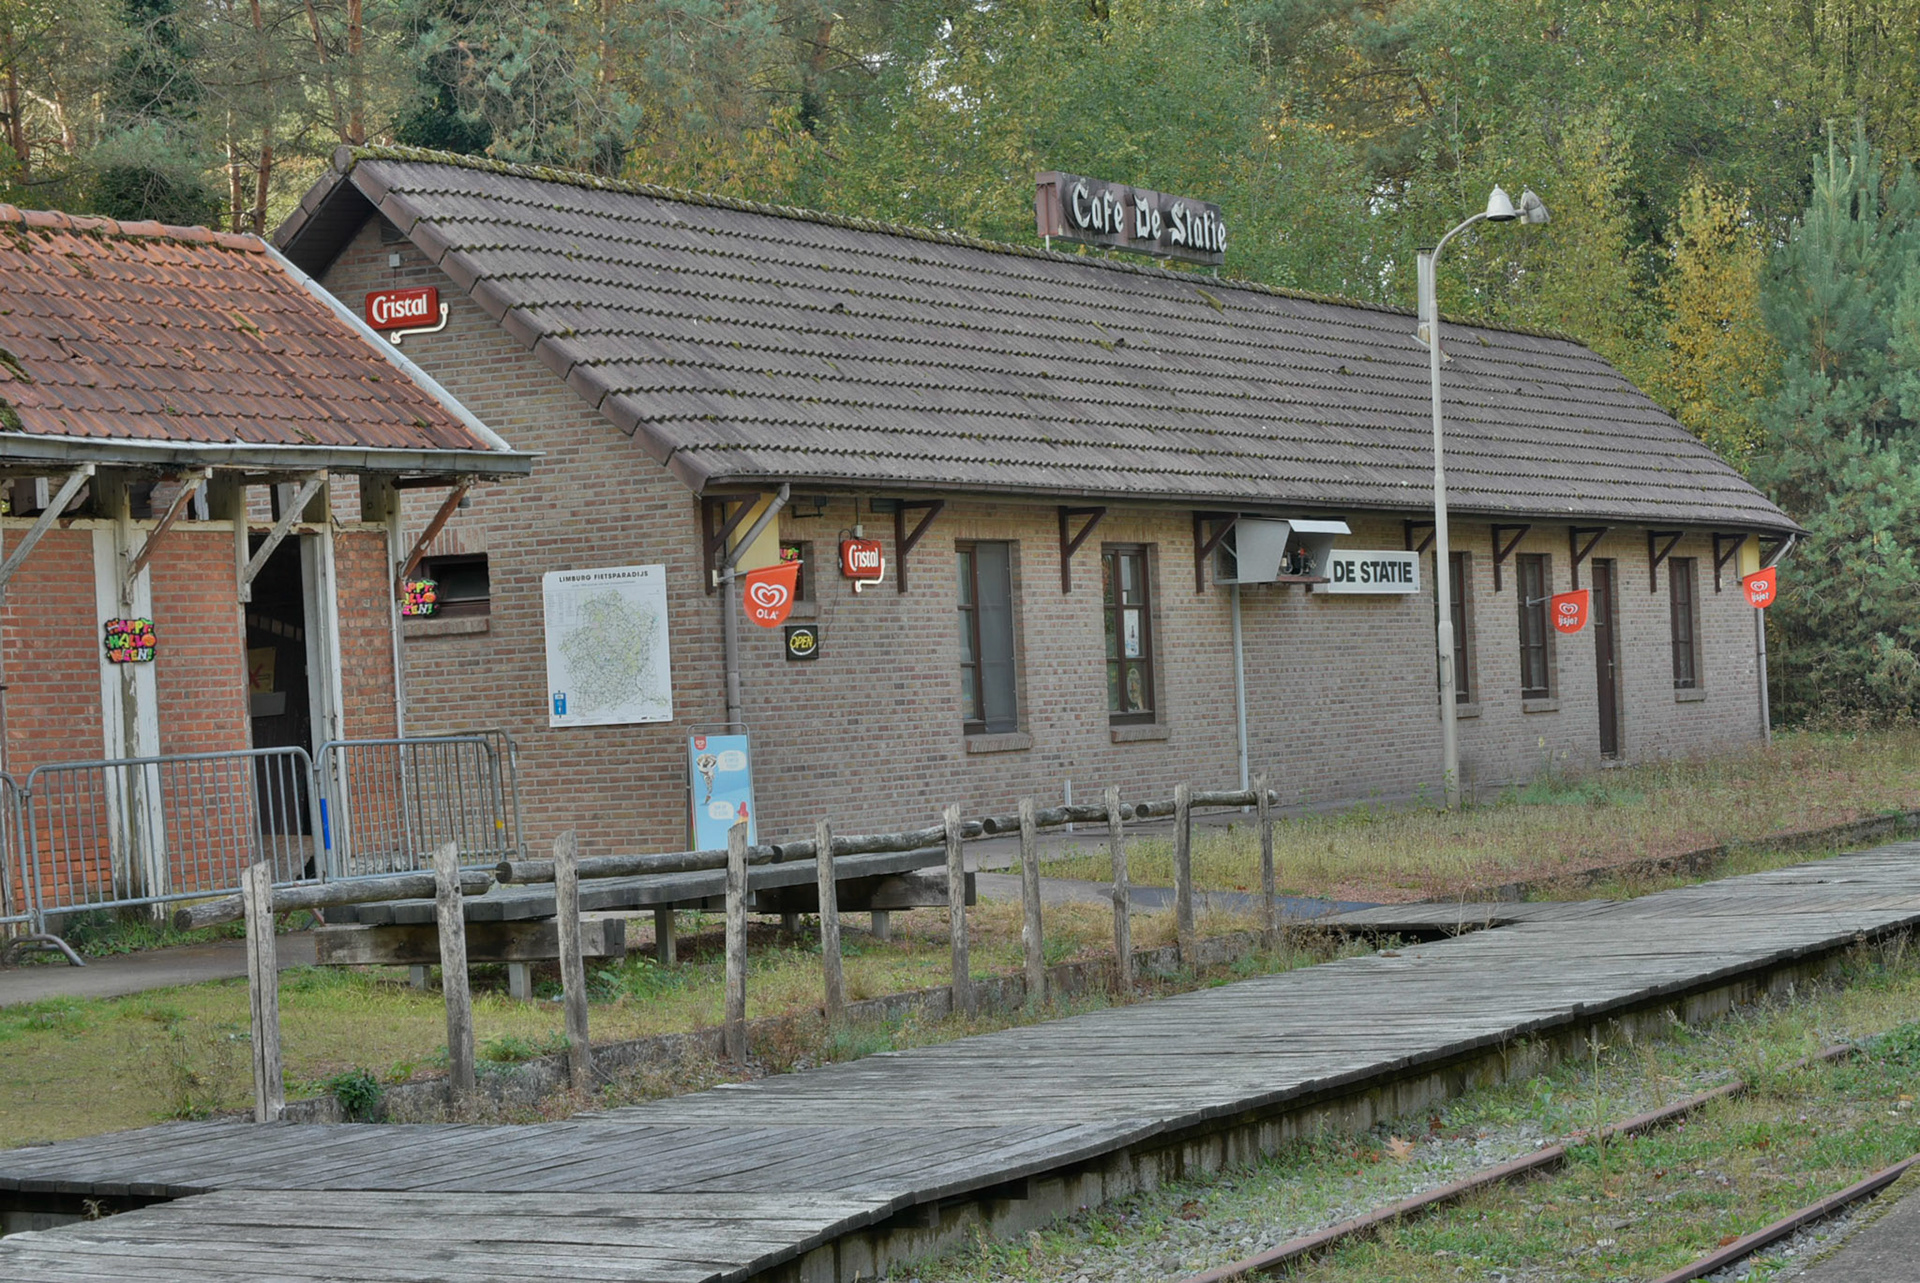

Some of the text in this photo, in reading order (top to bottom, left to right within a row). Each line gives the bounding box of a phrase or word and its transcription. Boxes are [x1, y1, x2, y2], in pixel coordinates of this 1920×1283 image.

[1134, 194, 1162, 240] De
[1168, 200, 1227, 253] Statie
[372, 293, 428, 324] Cristal
[848, 544, 879, 571] Cristal
[558, 570, 649, 583] LIMBURG FIETSPARADIJS
[1333, 560, 1413, 583] DE STATIE
[756, 608, 777, 620] OLA
[789, 635, 814, 649] OPEN
